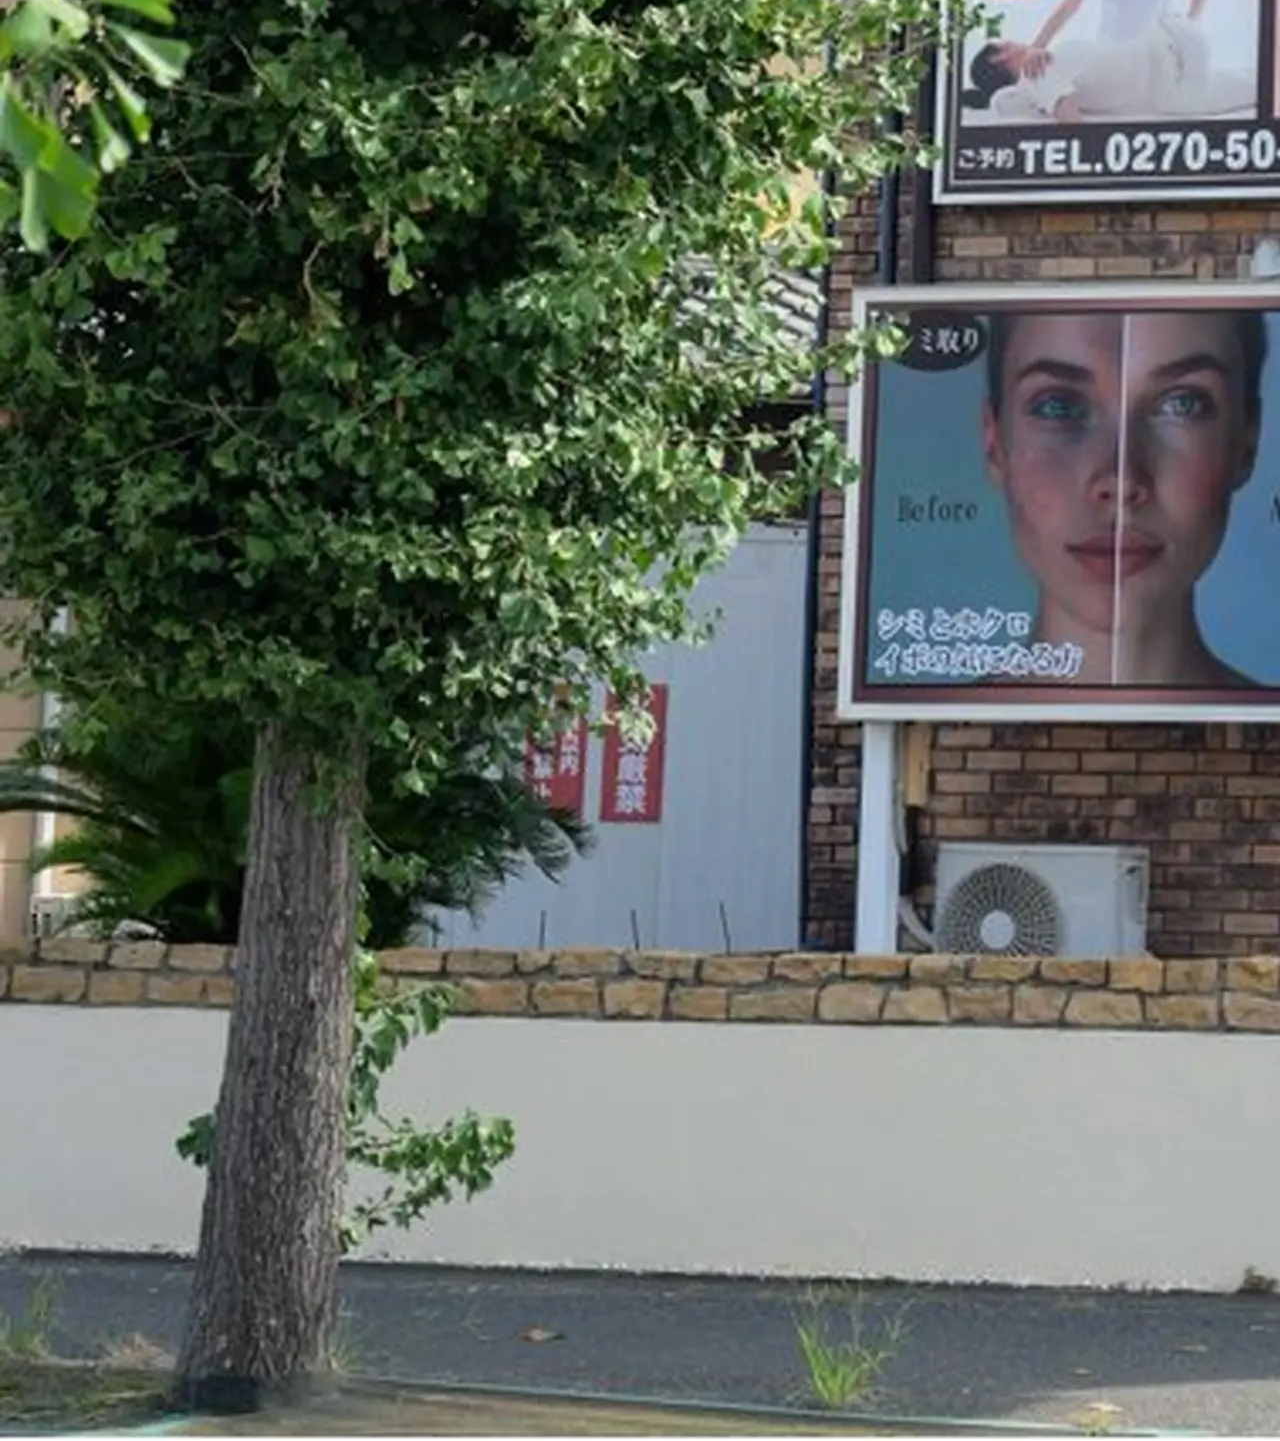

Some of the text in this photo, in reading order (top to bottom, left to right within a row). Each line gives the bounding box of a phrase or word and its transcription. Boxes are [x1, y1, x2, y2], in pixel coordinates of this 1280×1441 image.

[958, 147, 1015, 169] ご予約
[898, 326, 980, 354] ミ取り
[897, 494, 979, 523] Before
[877, 607, 1032, 642] シミとホクロ
[874, 641, 1085, 678] イボの気になる方
